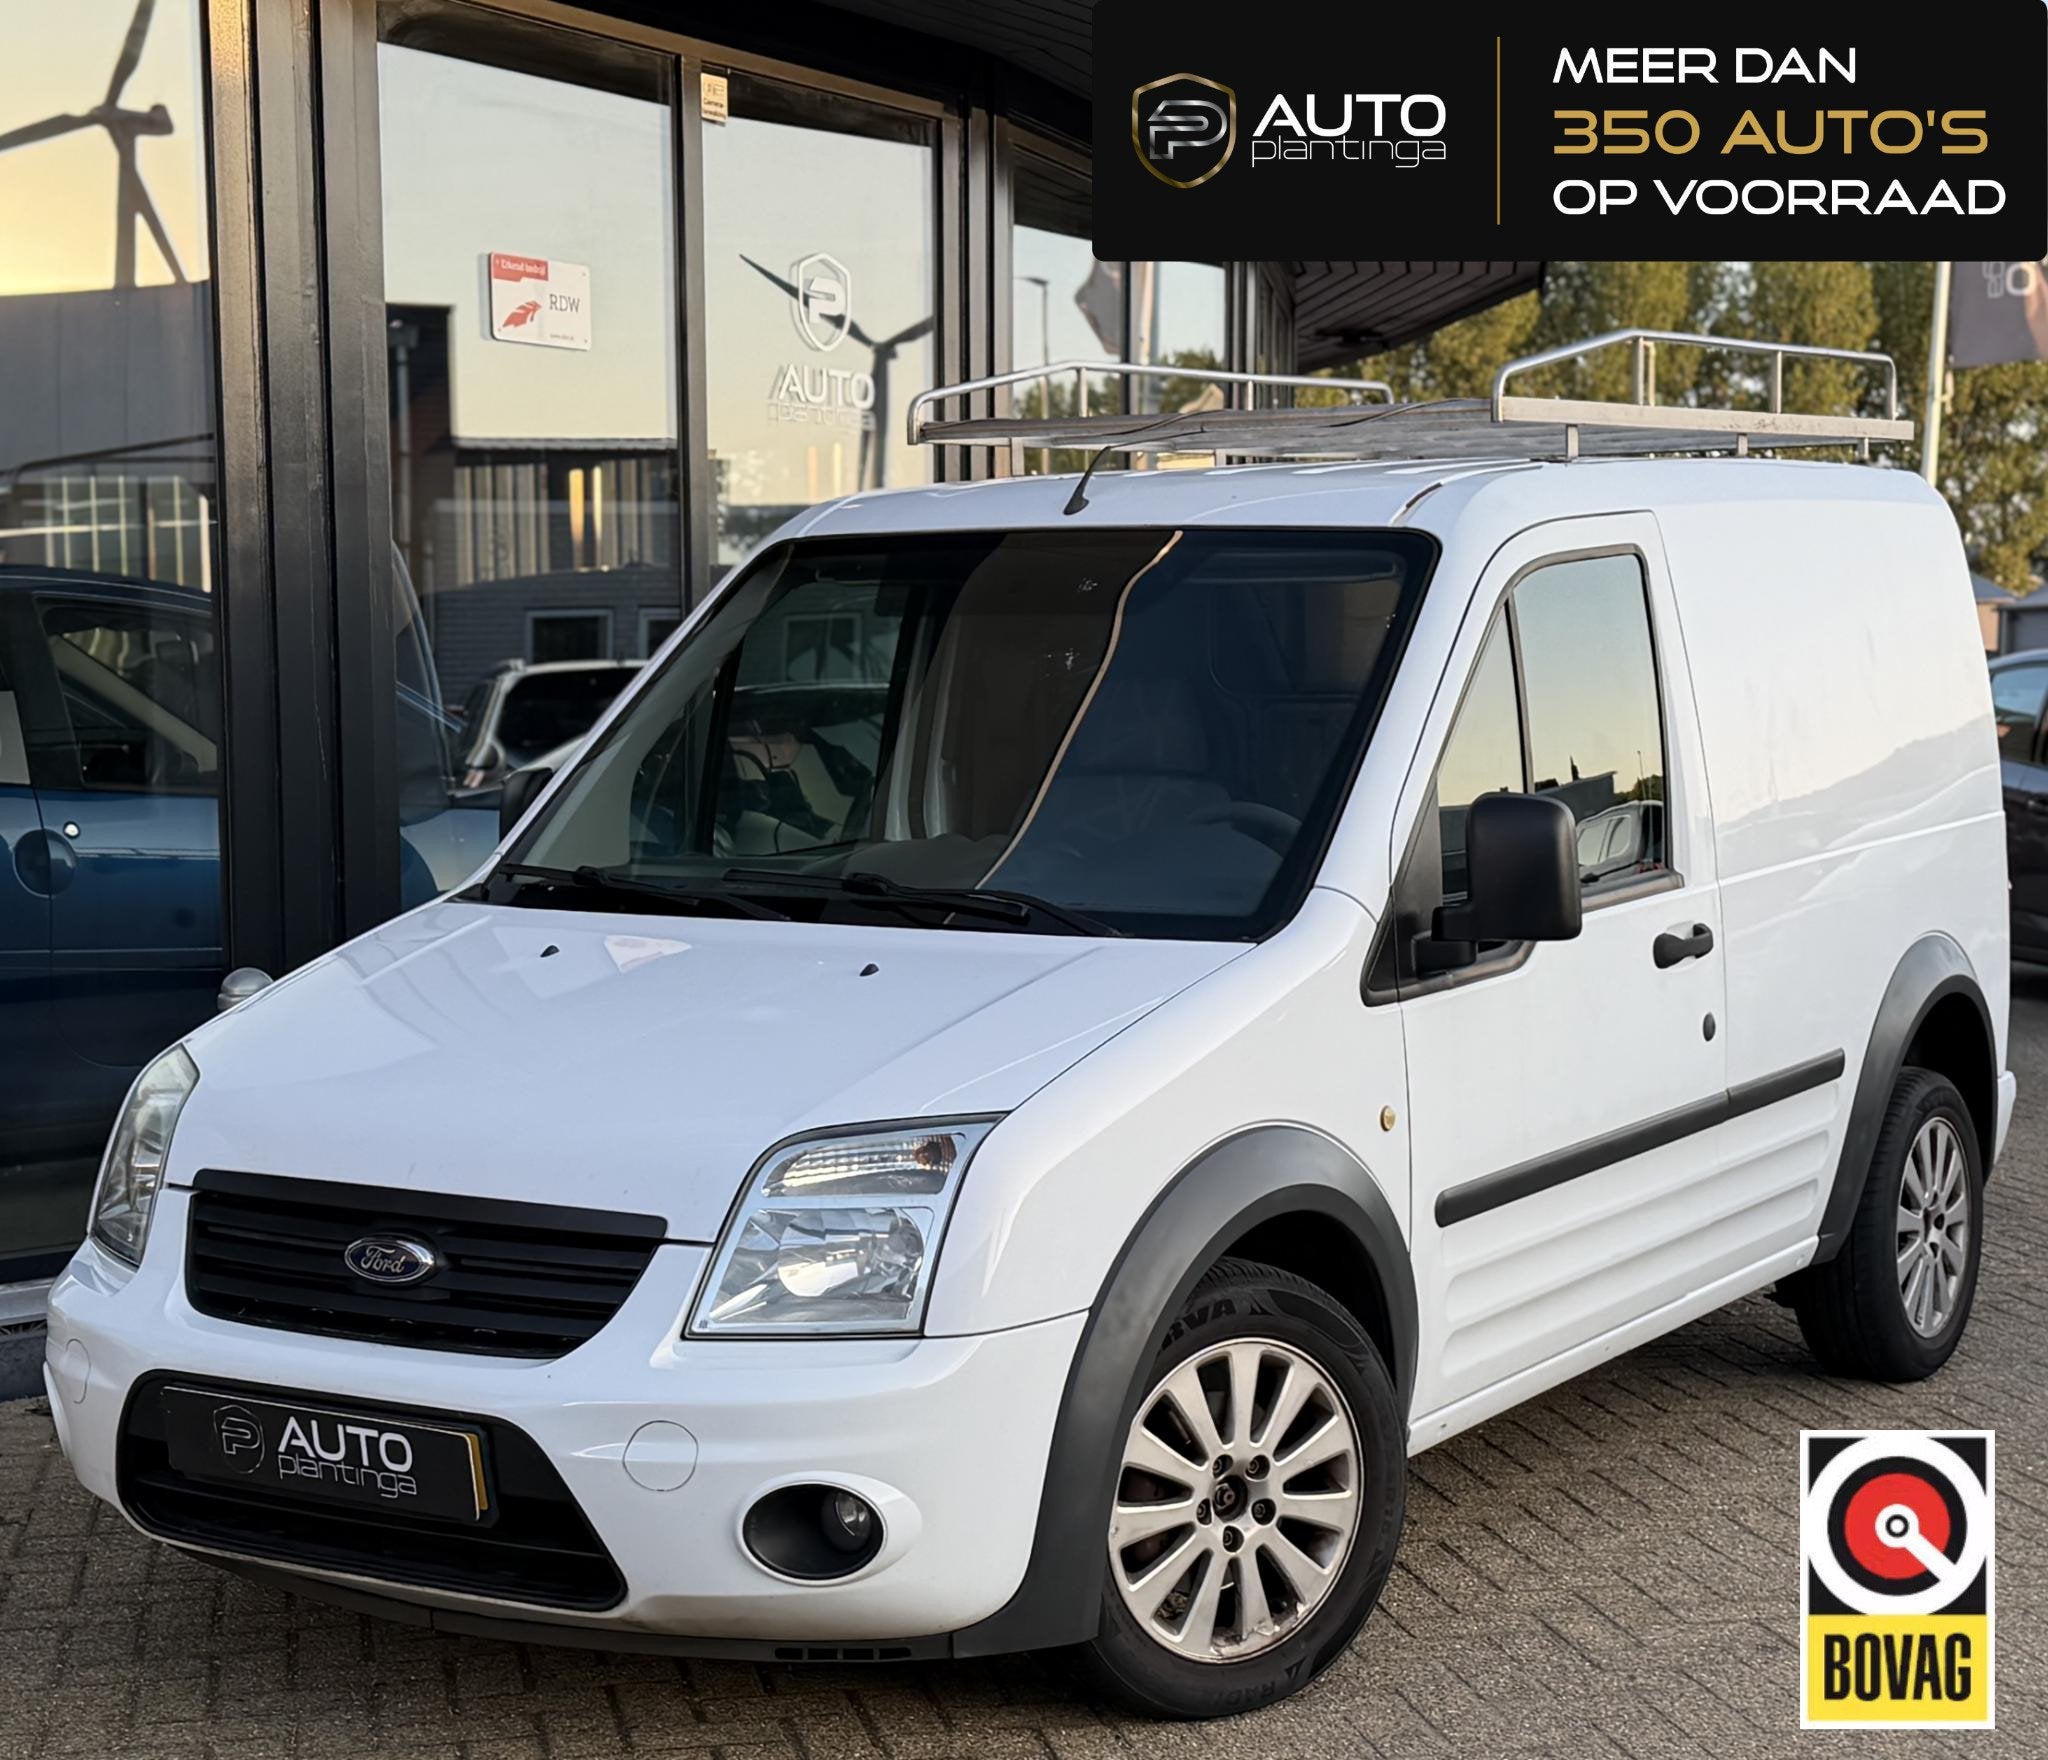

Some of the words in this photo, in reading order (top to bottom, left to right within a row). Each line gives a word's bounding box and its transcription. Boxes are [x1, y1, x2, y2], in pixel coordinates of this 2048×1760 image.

[549, 293, 580, 313] RDW
[778, 363, 875, 411] AUTO
[360, 1245, 405, 1274] Ford
[278, 1416, 413, 1472] AUTO
[278, 1454, 418, 1499] plantinga
